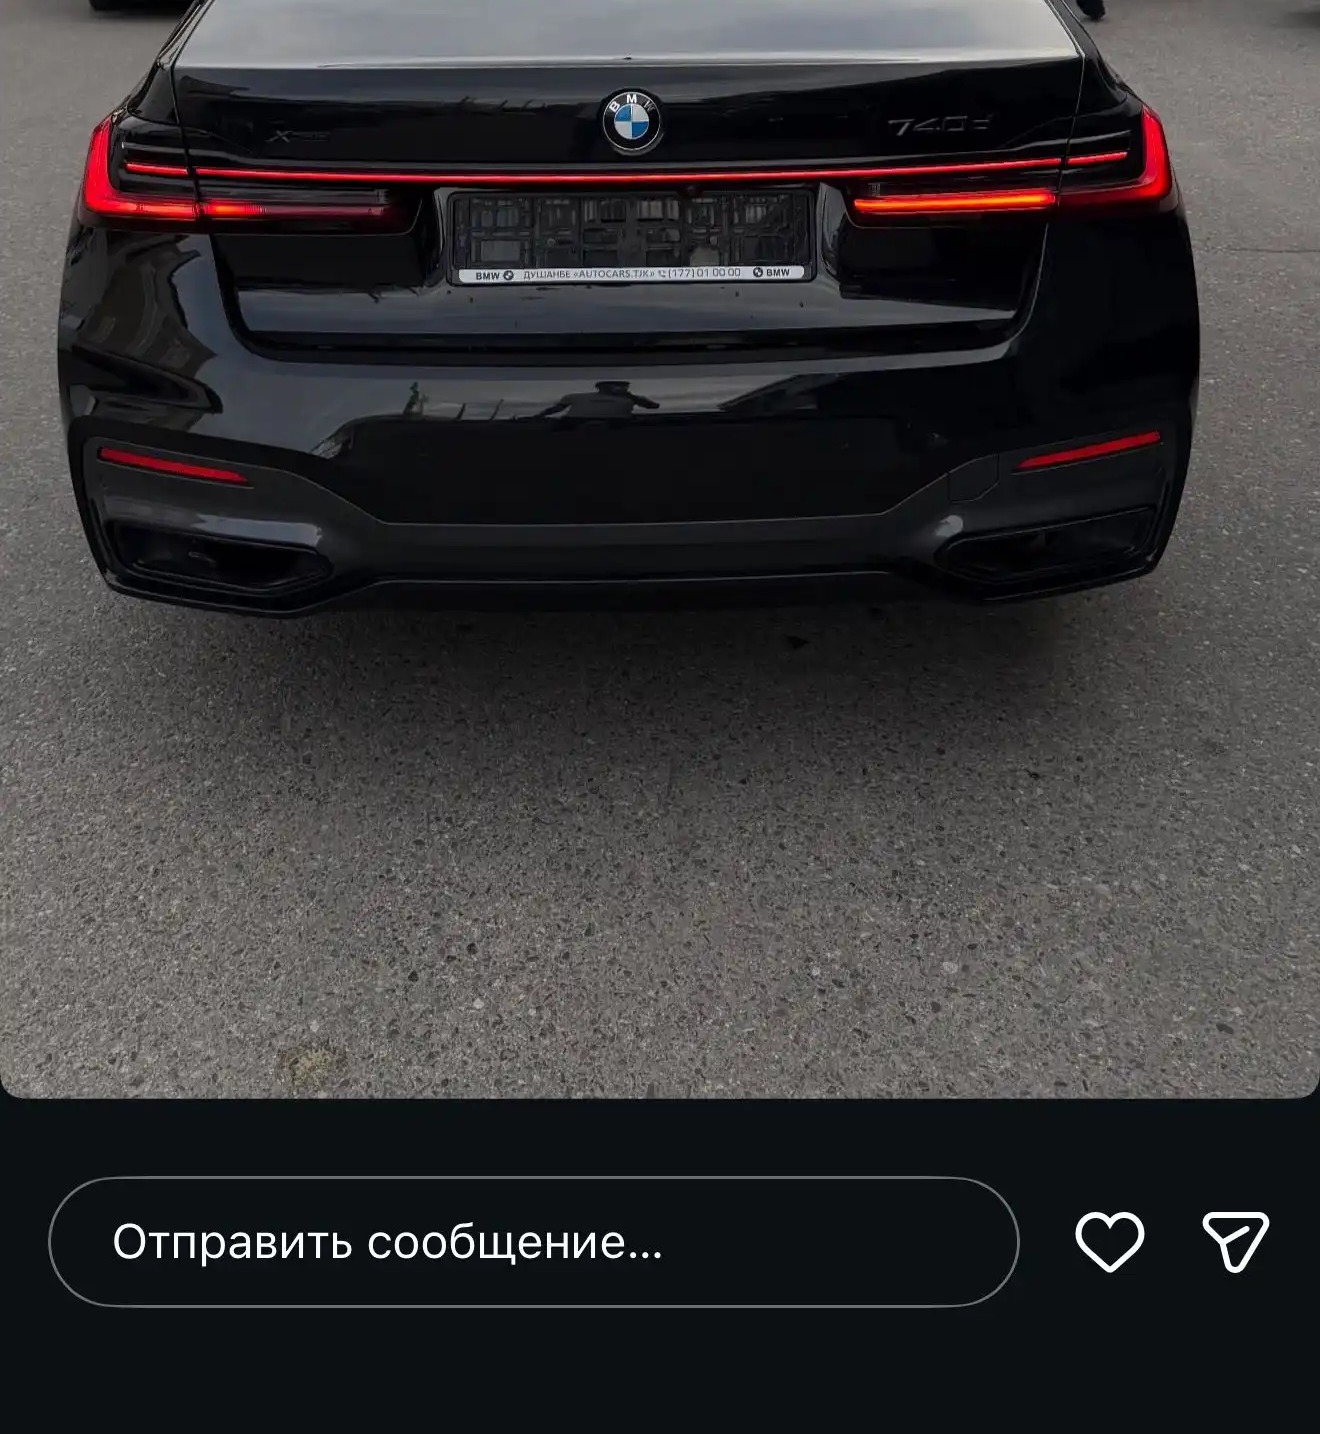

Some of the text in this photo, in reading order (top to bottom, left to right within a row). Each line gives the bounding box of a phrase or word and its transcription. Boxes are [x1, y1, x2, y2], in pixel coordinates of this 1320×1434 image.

[608, 93, 657, 113] BMW
[475, 271, 500, 281] BMW
[523, 270, 571, 281] ДУШАНБЕ
[668, 268, 695, 279] (177)
[697, 268, 709, 278] 01
[766, 268, 790, 277] BMW
